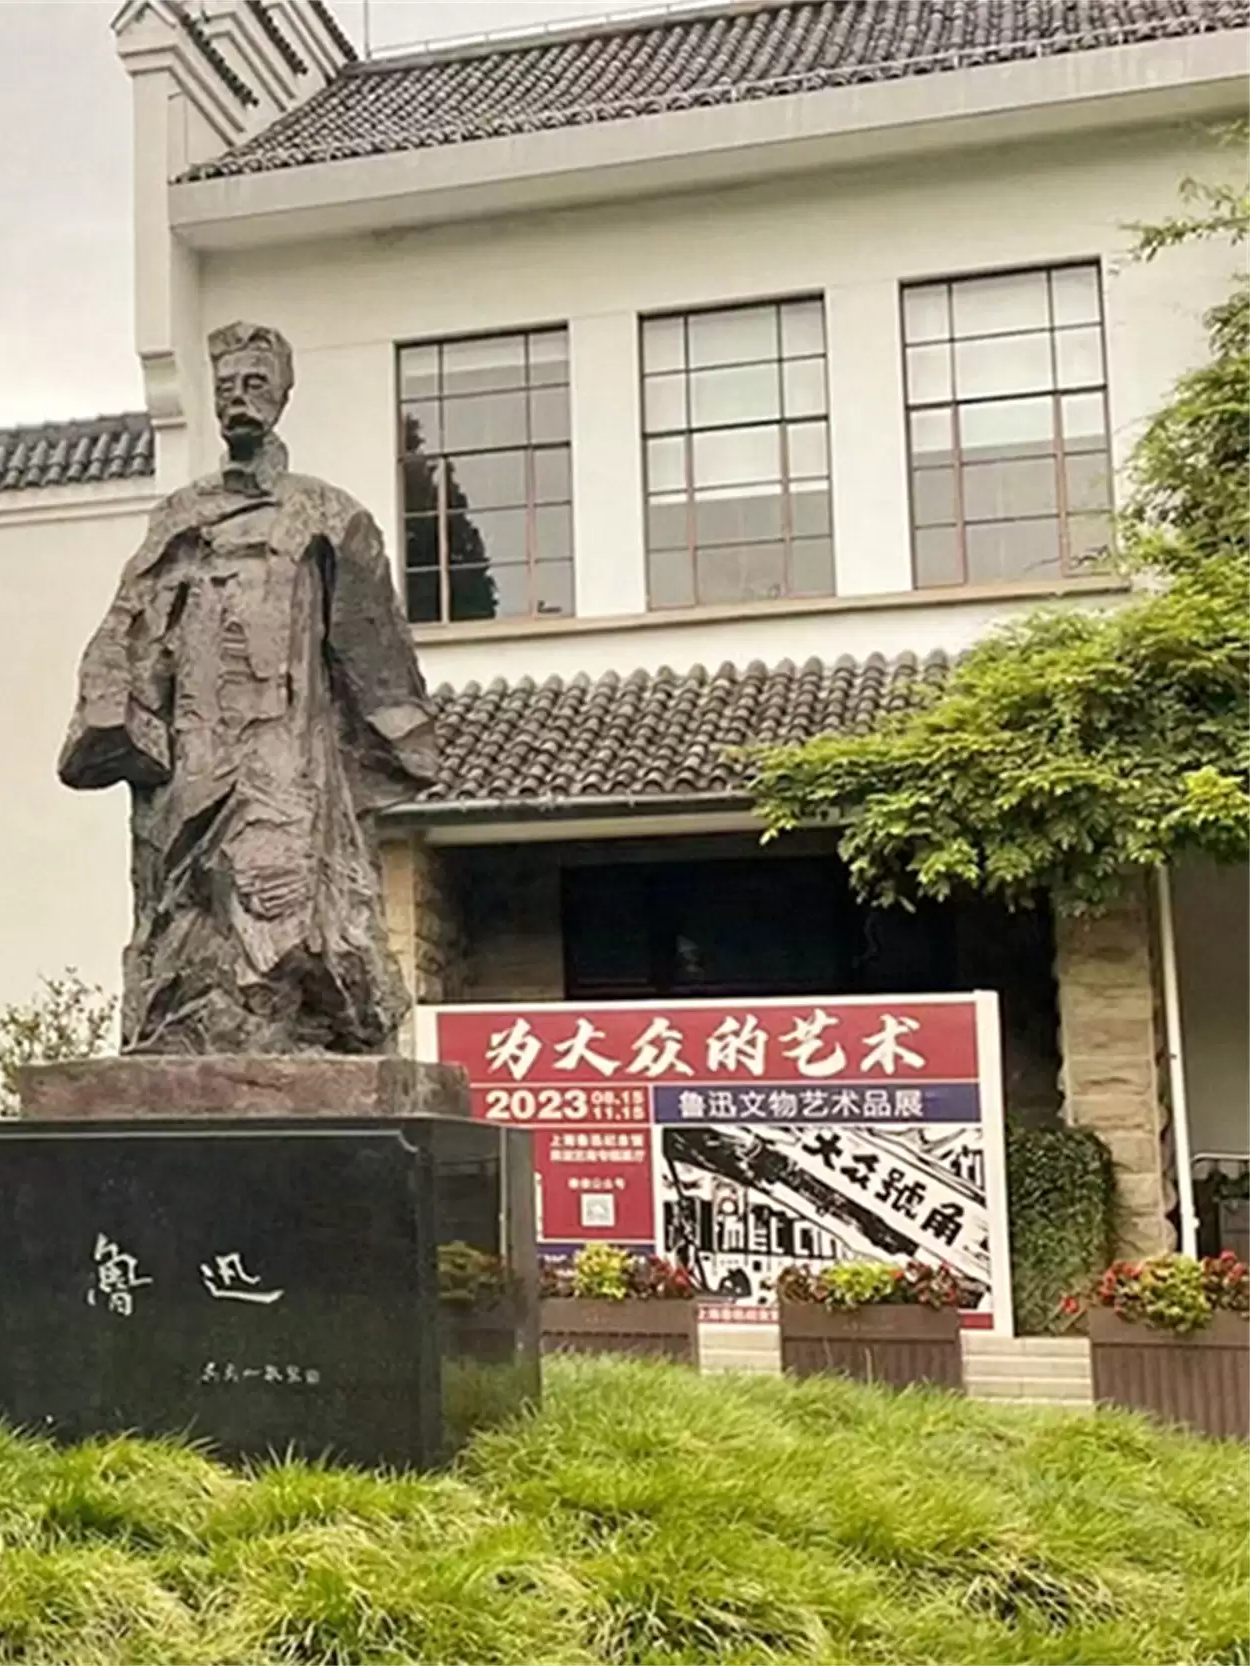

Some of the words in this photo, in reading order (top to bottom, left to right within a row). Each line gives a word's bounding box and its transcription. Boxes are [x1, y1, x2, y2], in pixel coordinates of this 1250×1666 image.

[486, 1009, 927, 1081] 为大众的艺术
[486, 1088, 588, 1120] 2023
[678, 1089, 924, 1119] 鲁迅文物艺术品展
